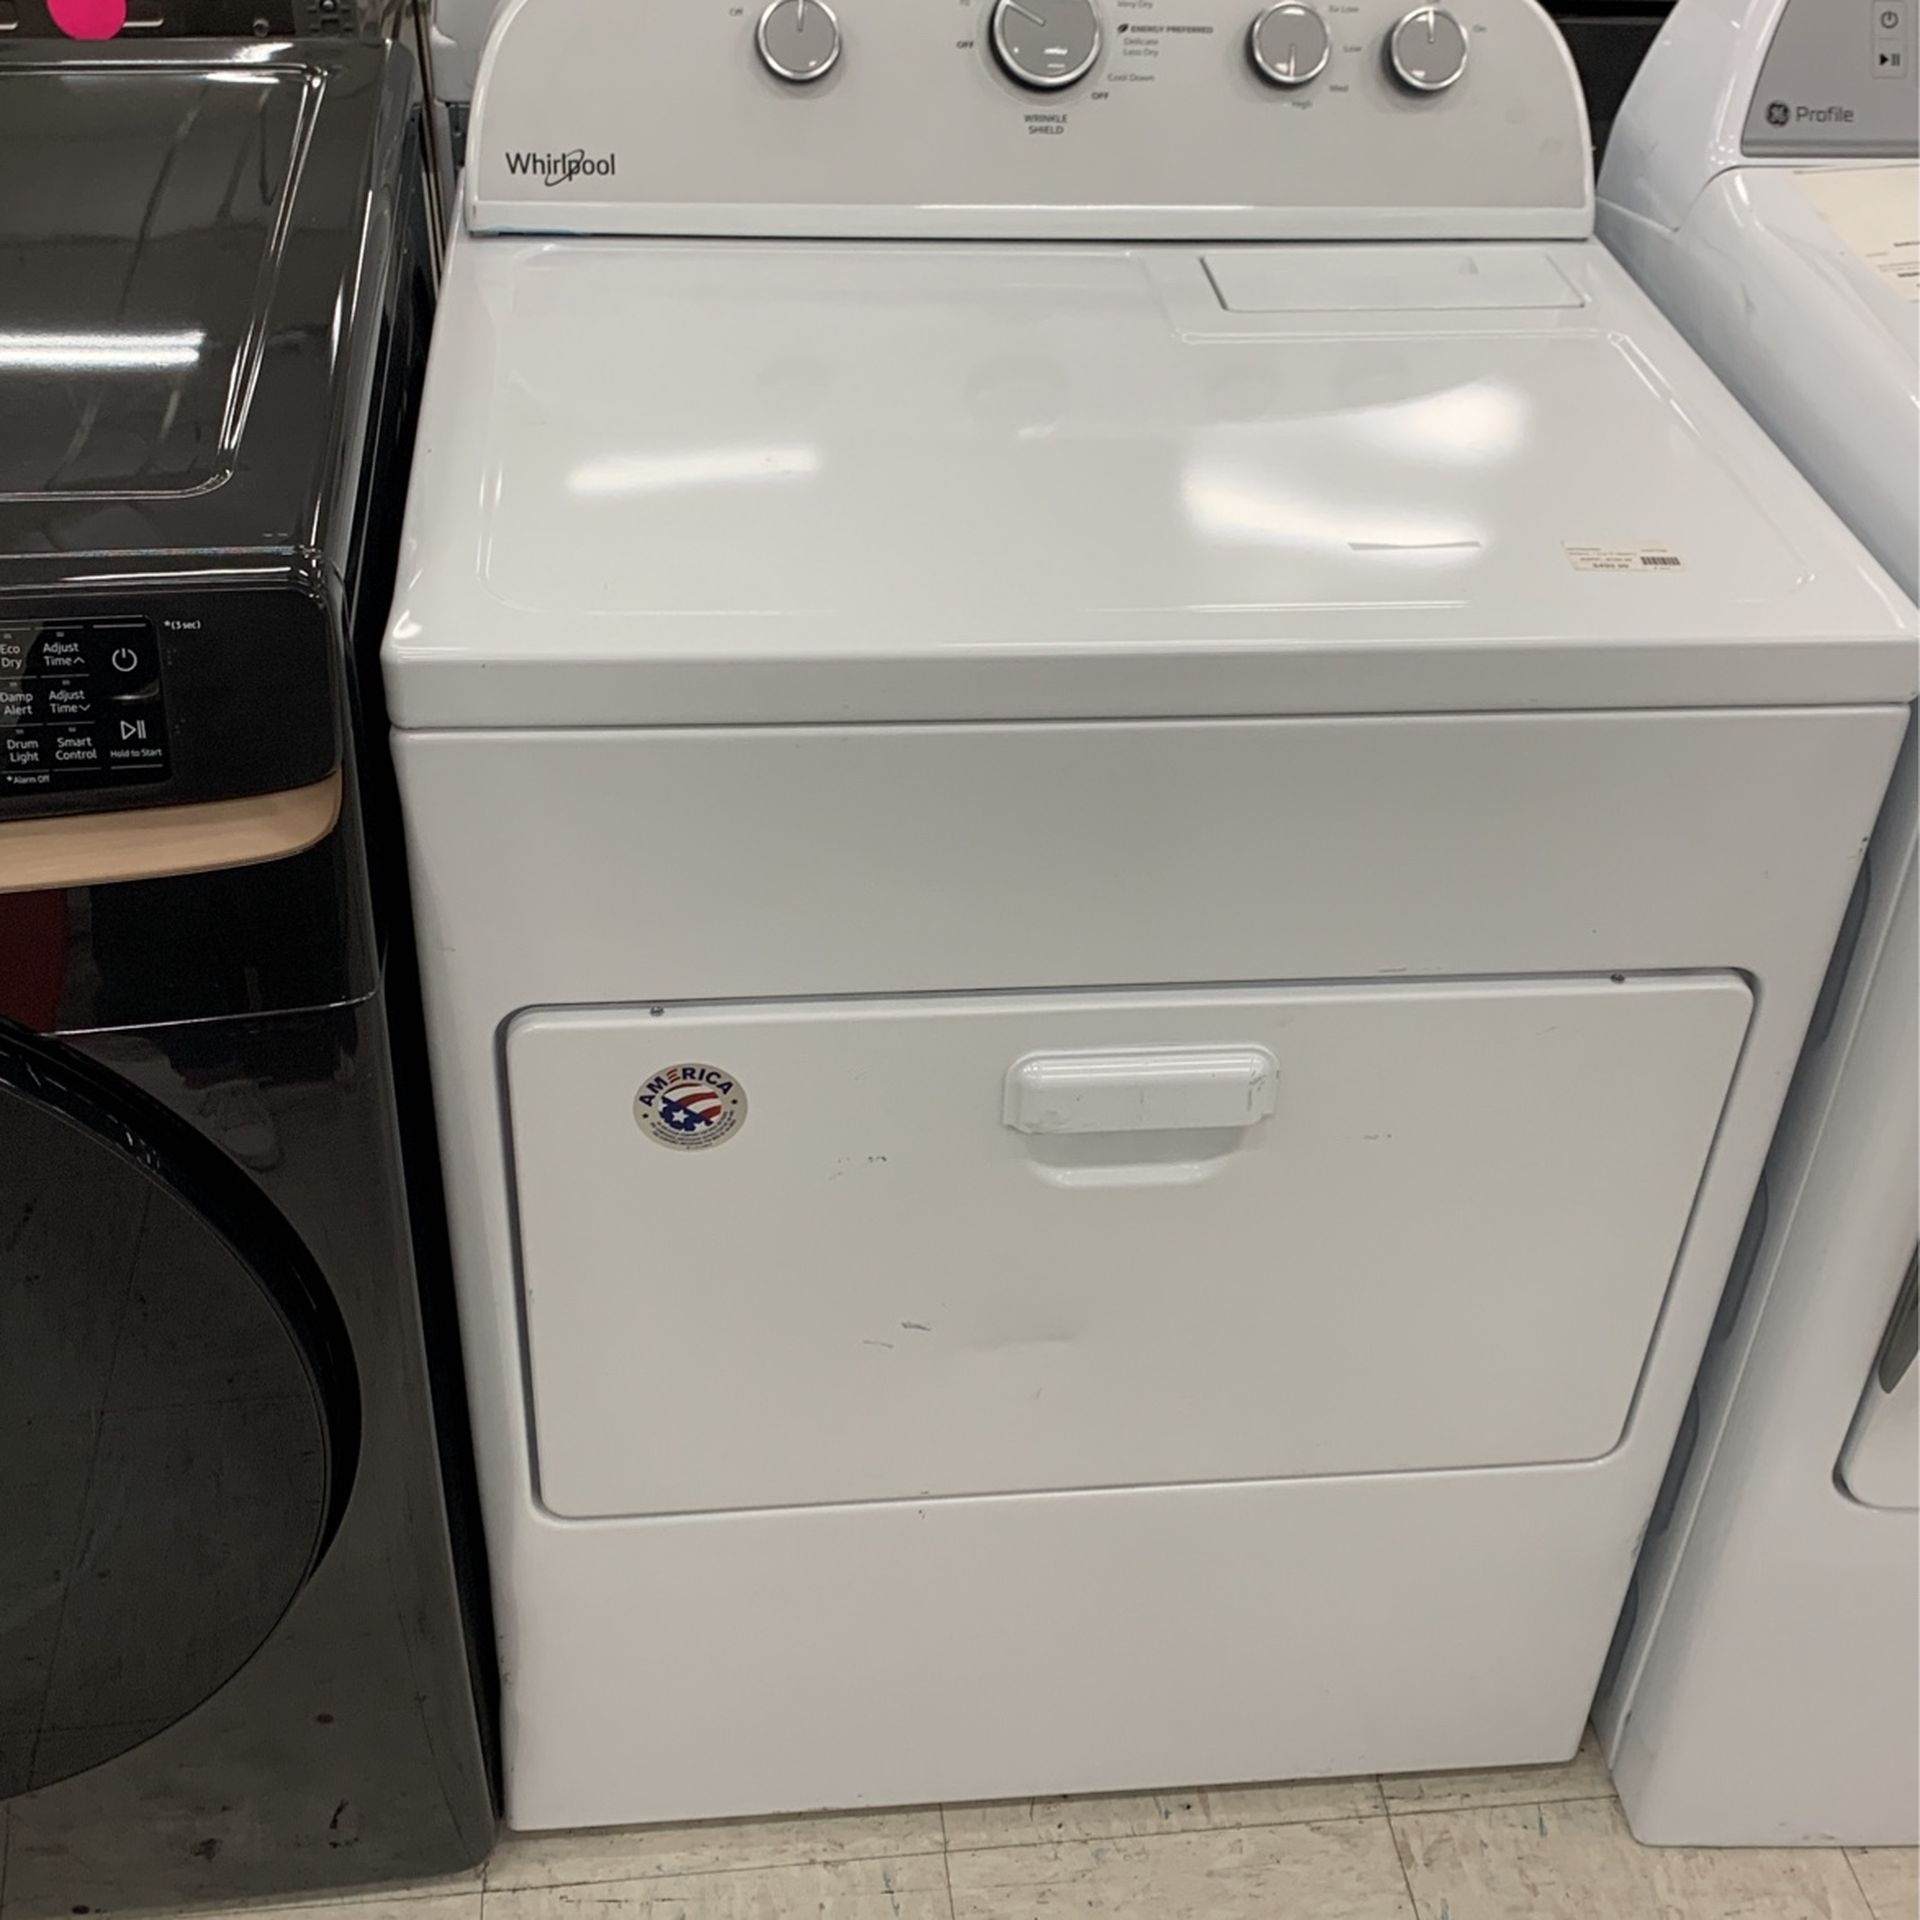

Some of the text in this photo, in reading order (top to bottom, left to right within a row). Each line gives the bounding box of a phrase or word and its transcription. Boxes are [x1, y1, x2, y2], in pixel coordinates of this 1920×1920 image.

[1131, 25, 1214, 34] ENERGY PREFERRED
[956, 40, 974, 49] OFF
[1107, 74, 1155, 82] Cool Down
[1091, 92, 1109, 100] OFF
[1024, 114, 1067, 124] WRINKLE
[1796, 106, 1854, 123] Profile
[1029, 125, 1064, 135] SHIELD
[505, 150, 616, 185] Whirlpool
[1, 644, 21, 655] Eco
[43, 642, 79, 655] Adjust
[1, 657, 22, 669] Dry
[44, 655, 72, 666] Time
[0, 691, 33, 704] Damp
[49, 690, 85, 702] Adjust
[4, 704, 33, 715] Alert
[50, 703, 78, 713] Time
[7, 739, 39, 749] Drum
[57, 737, 92, 748] Smart
[10, 751, 40, 764] Light
[55, 749, 97, 761] Control
[110, 750, 130, 758] Hold
[141, 748, 162, 757] Start
[37, 774, 50, 783] Off
[638, 1067, 734, 1107] AMERICA
